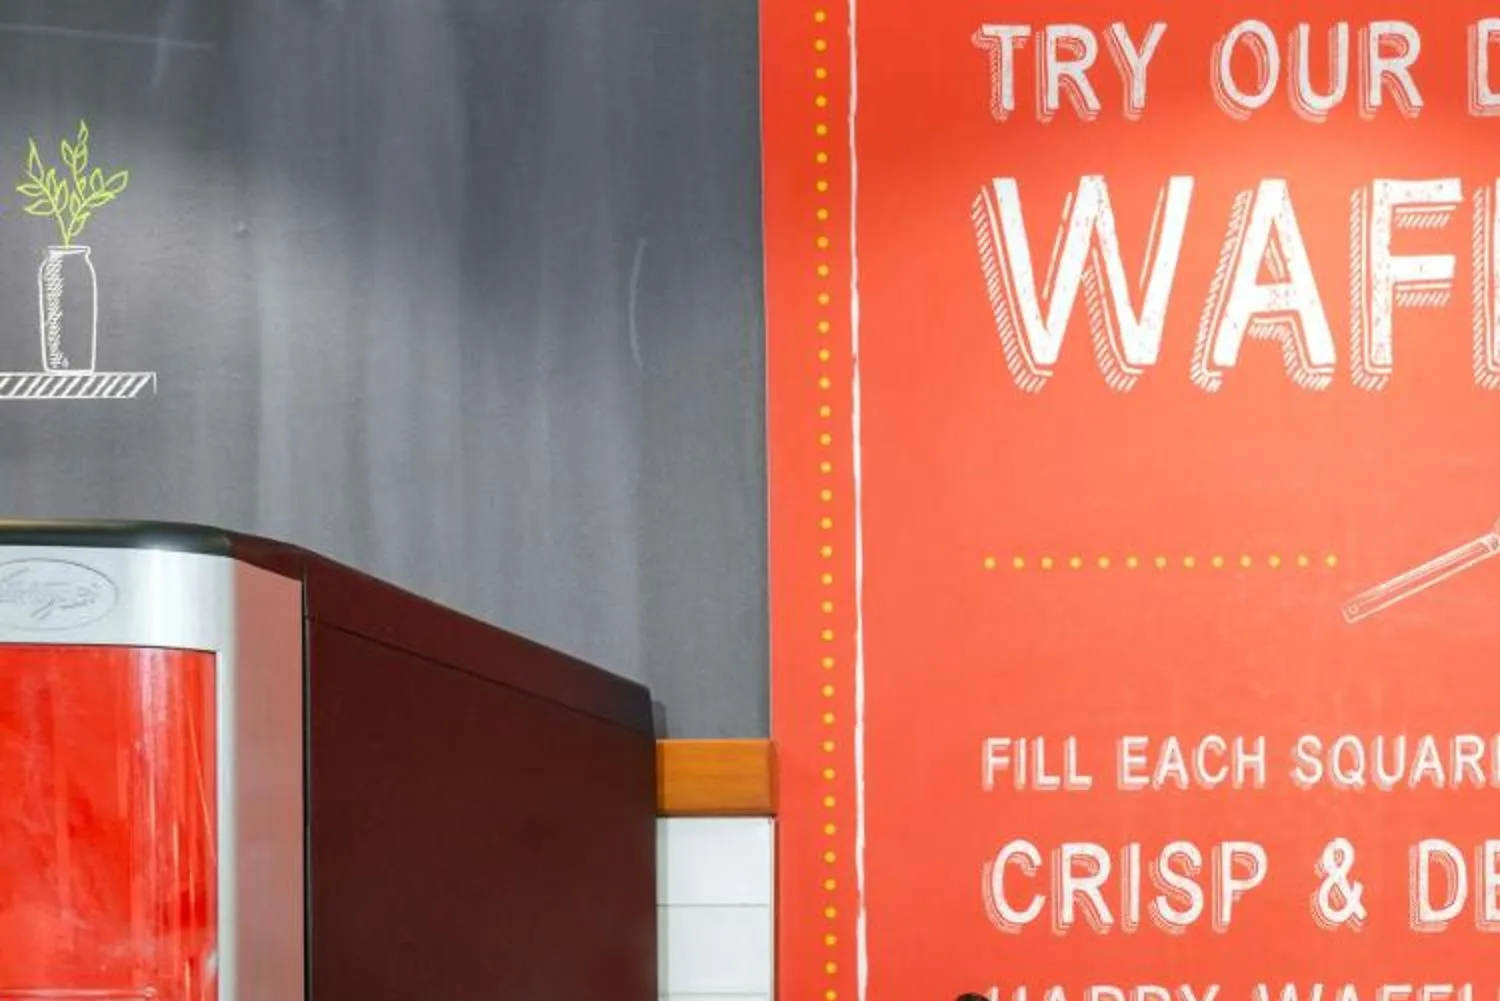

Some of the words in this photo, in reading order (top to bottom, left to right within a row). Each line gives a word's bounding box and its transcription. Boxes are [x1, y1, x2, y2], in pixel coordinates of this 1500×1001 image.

[971, 21, 1167, 122] TRY
[1210, 19, 1423, 122] OUR
[981, 736, 1093, 791] FILL
[1116, 734, 1266, 791] EACH
[982, 839, 1268, 935] CRISP
[1311, 837, 1367, 932] &
